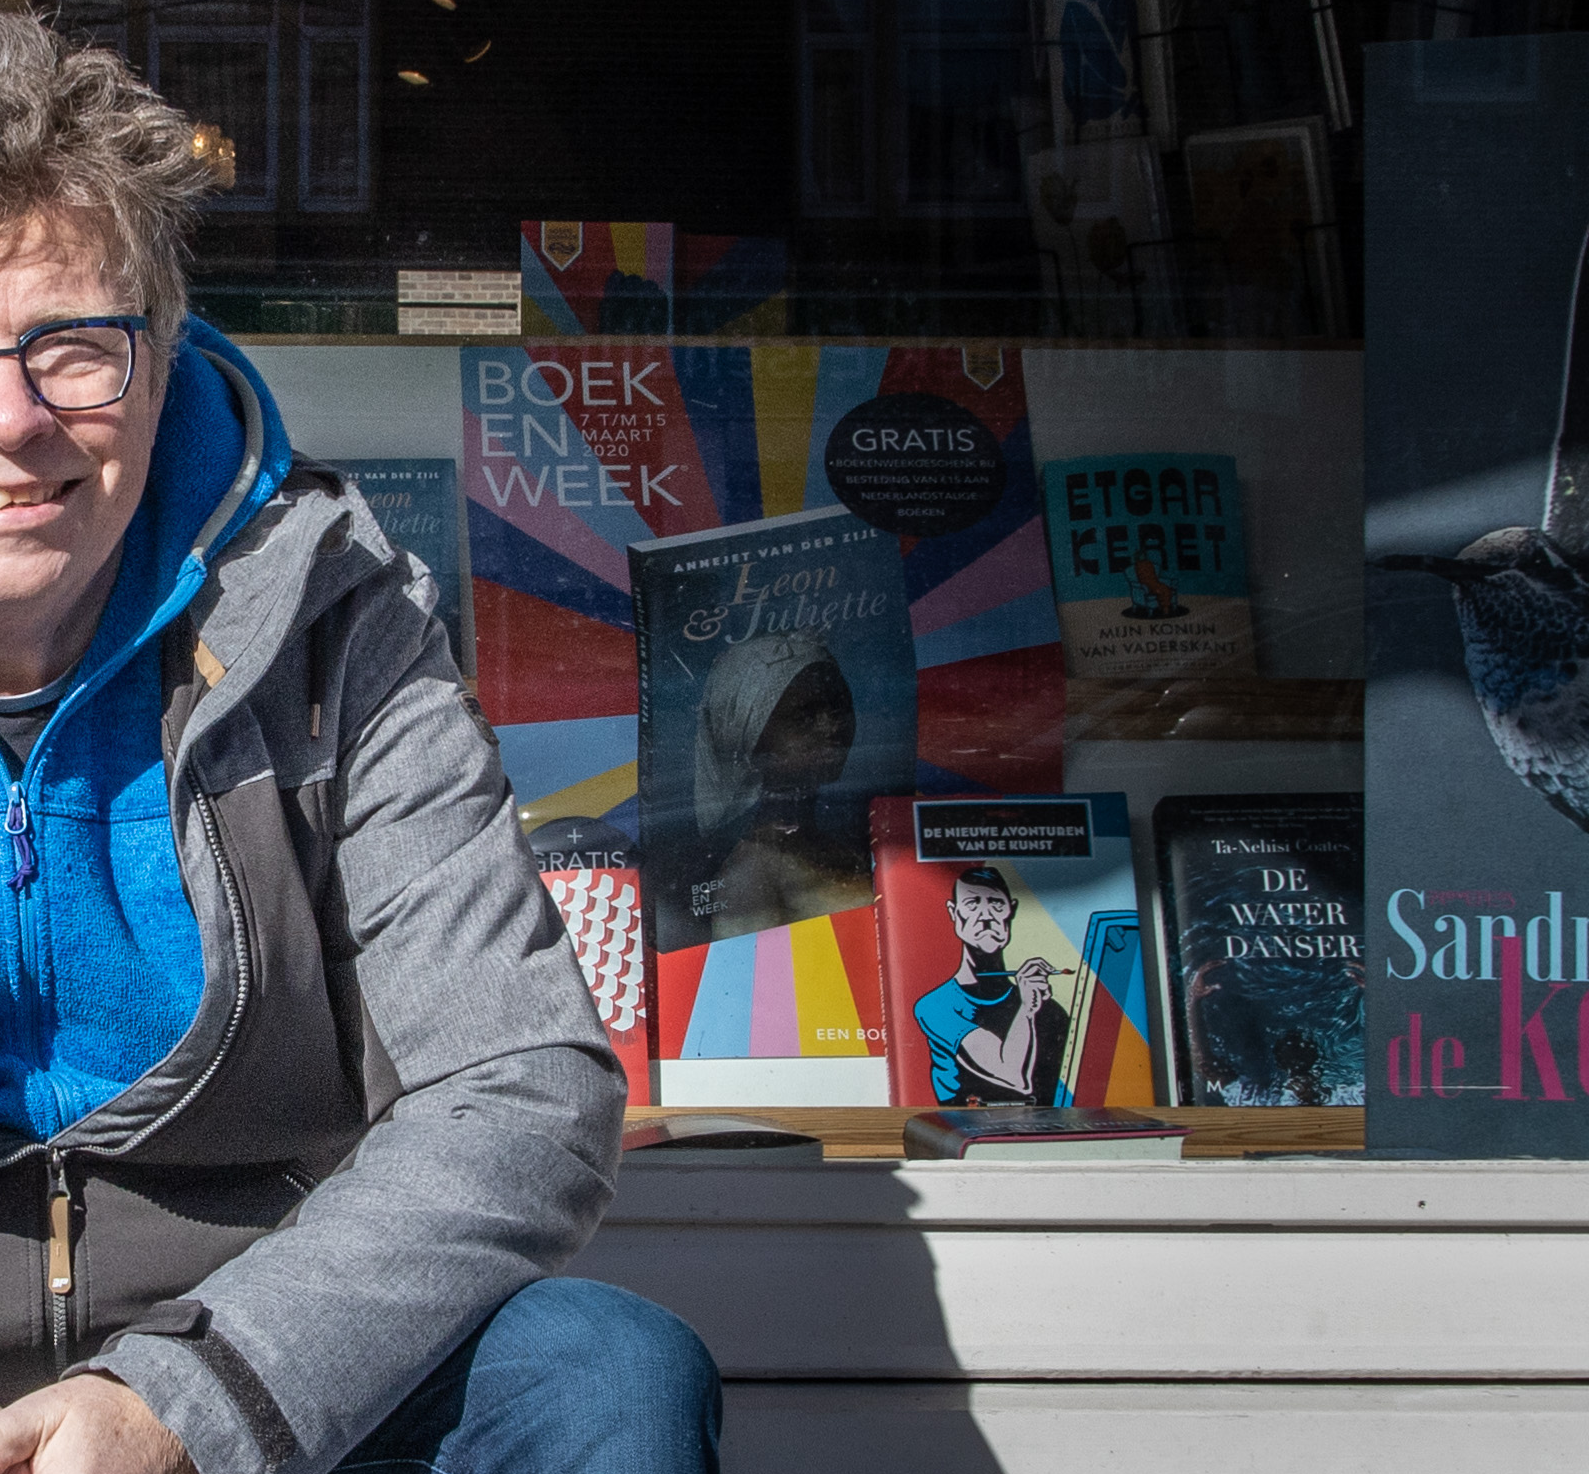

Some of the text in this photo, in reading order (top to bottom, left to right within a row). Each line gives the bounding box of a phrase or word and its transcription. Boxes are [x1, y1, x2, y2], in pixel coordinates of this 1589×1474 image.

[477, 360, 666, 407] BOEK
[480, 413, 667, 458] EN 7 T/M 15
[580, 428, 654, 443] MAART
[851, 428, 976, 453] GRATIS
[581, 444, 630, 457] 2020
[368, 491, 413, 509] eon
[1066, 467, 1223, 521] ETGAR
[673, 527, 880, 574] ANNEJET VAN DER ZIJL
[1071, 522, 1227, 577] KERET
[727, 561, 839, 606] Leon
[682, 588, 889, 645] & Juliette
[1099, 622, 1216, 640] MIJN KONIJN
[1079, 640, 1238, 658] VAN VADERSKANT
[923, 825, 1086, 838] DE NIEUWE AVONTUREN
[957, 839, 1054, 851] VAN DE KUNST
[1211, 837, 1352, 855] Ta-Nehisi Coates
[1261, 868, 1310, 893] DE
[691, 893, 711, 907] EN
[1227, 902, 1350, 927] WATER
[1223, 934, 1362, 959] DANSER
[815, 1027, 851, 1041] EEN
[1386, 1011, 1466, 1099] de
